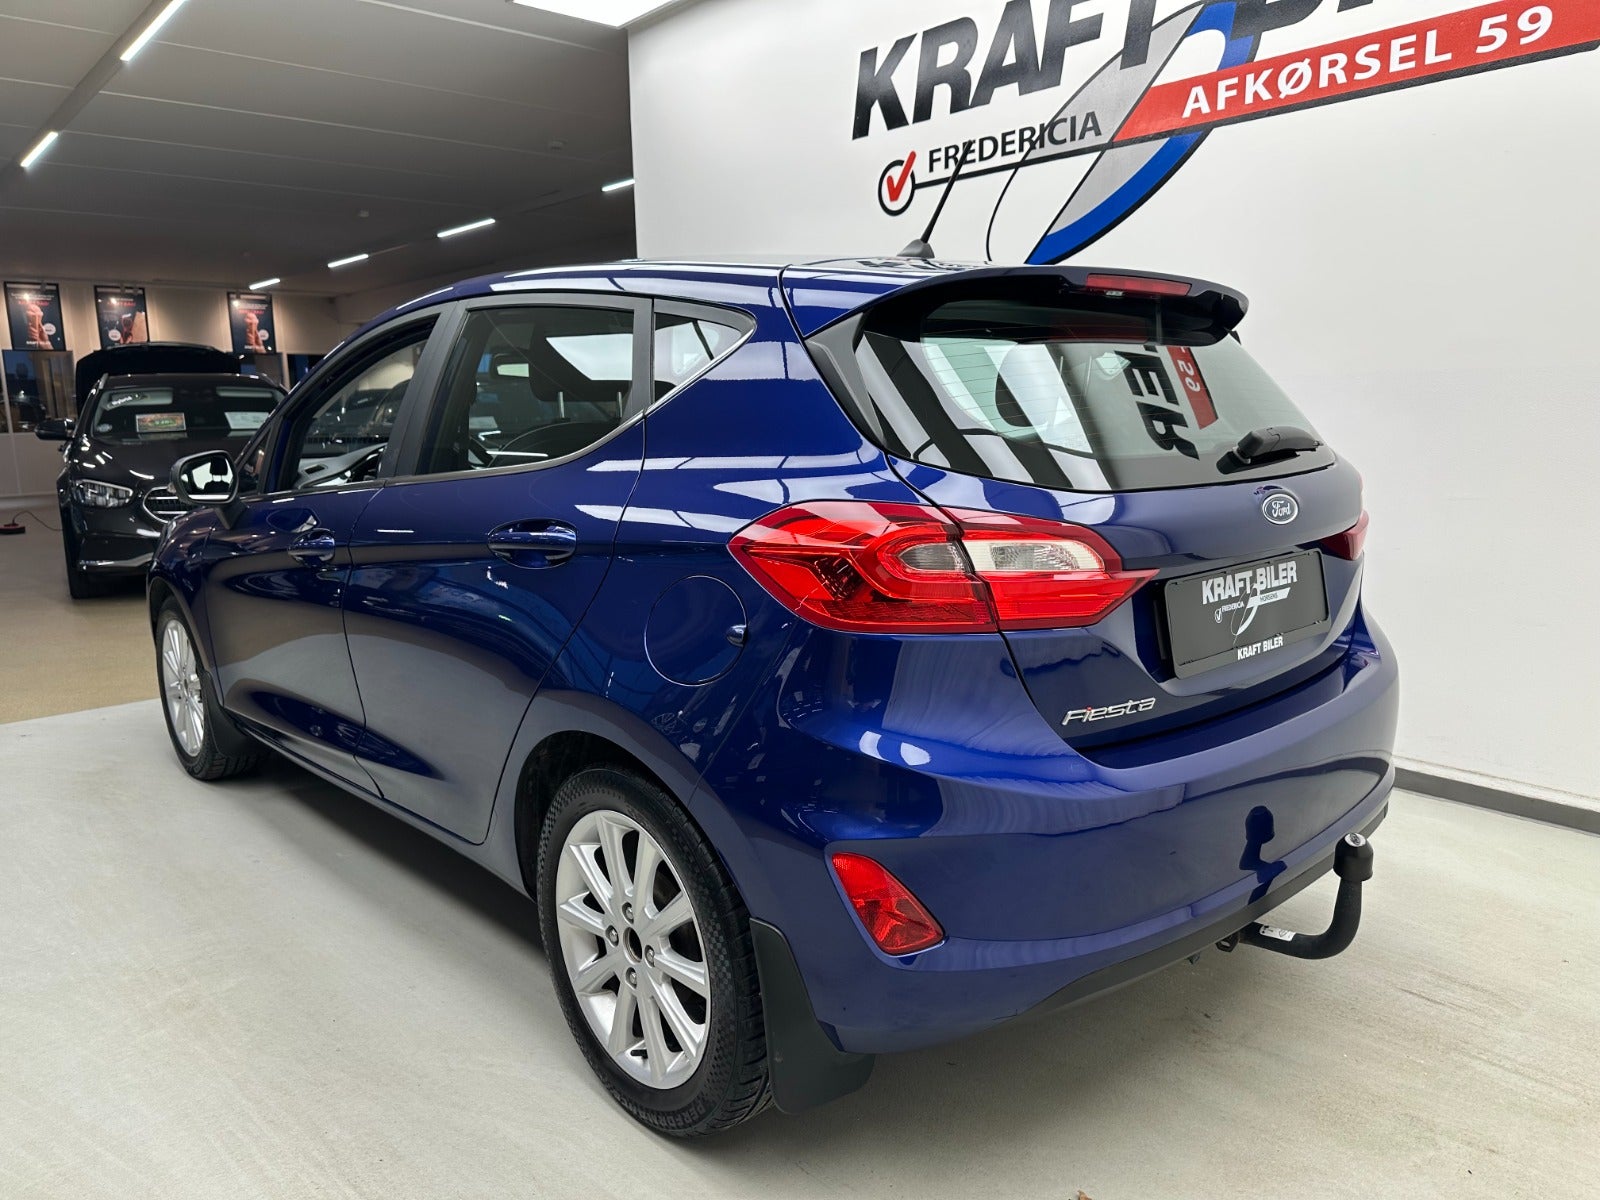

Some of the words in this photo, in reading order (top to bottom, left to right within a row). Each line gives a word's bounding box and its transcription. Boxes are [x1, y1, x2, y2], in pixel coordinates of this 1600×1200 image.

[1182, 29, 1452, 118] AFKØRSEL
[1476, 5, 1553, 54] 59
[1272, 500, 1291, 517] Ford
[1202, 570, 1252, 604] KRAFT
[1256, 561, 1297, 590] BILER
[1237, 643, 1261, 660] KRAFT
[1262, 636, 1283, 651] BILER
[1062, 697, 1156, 725] Fiesta
